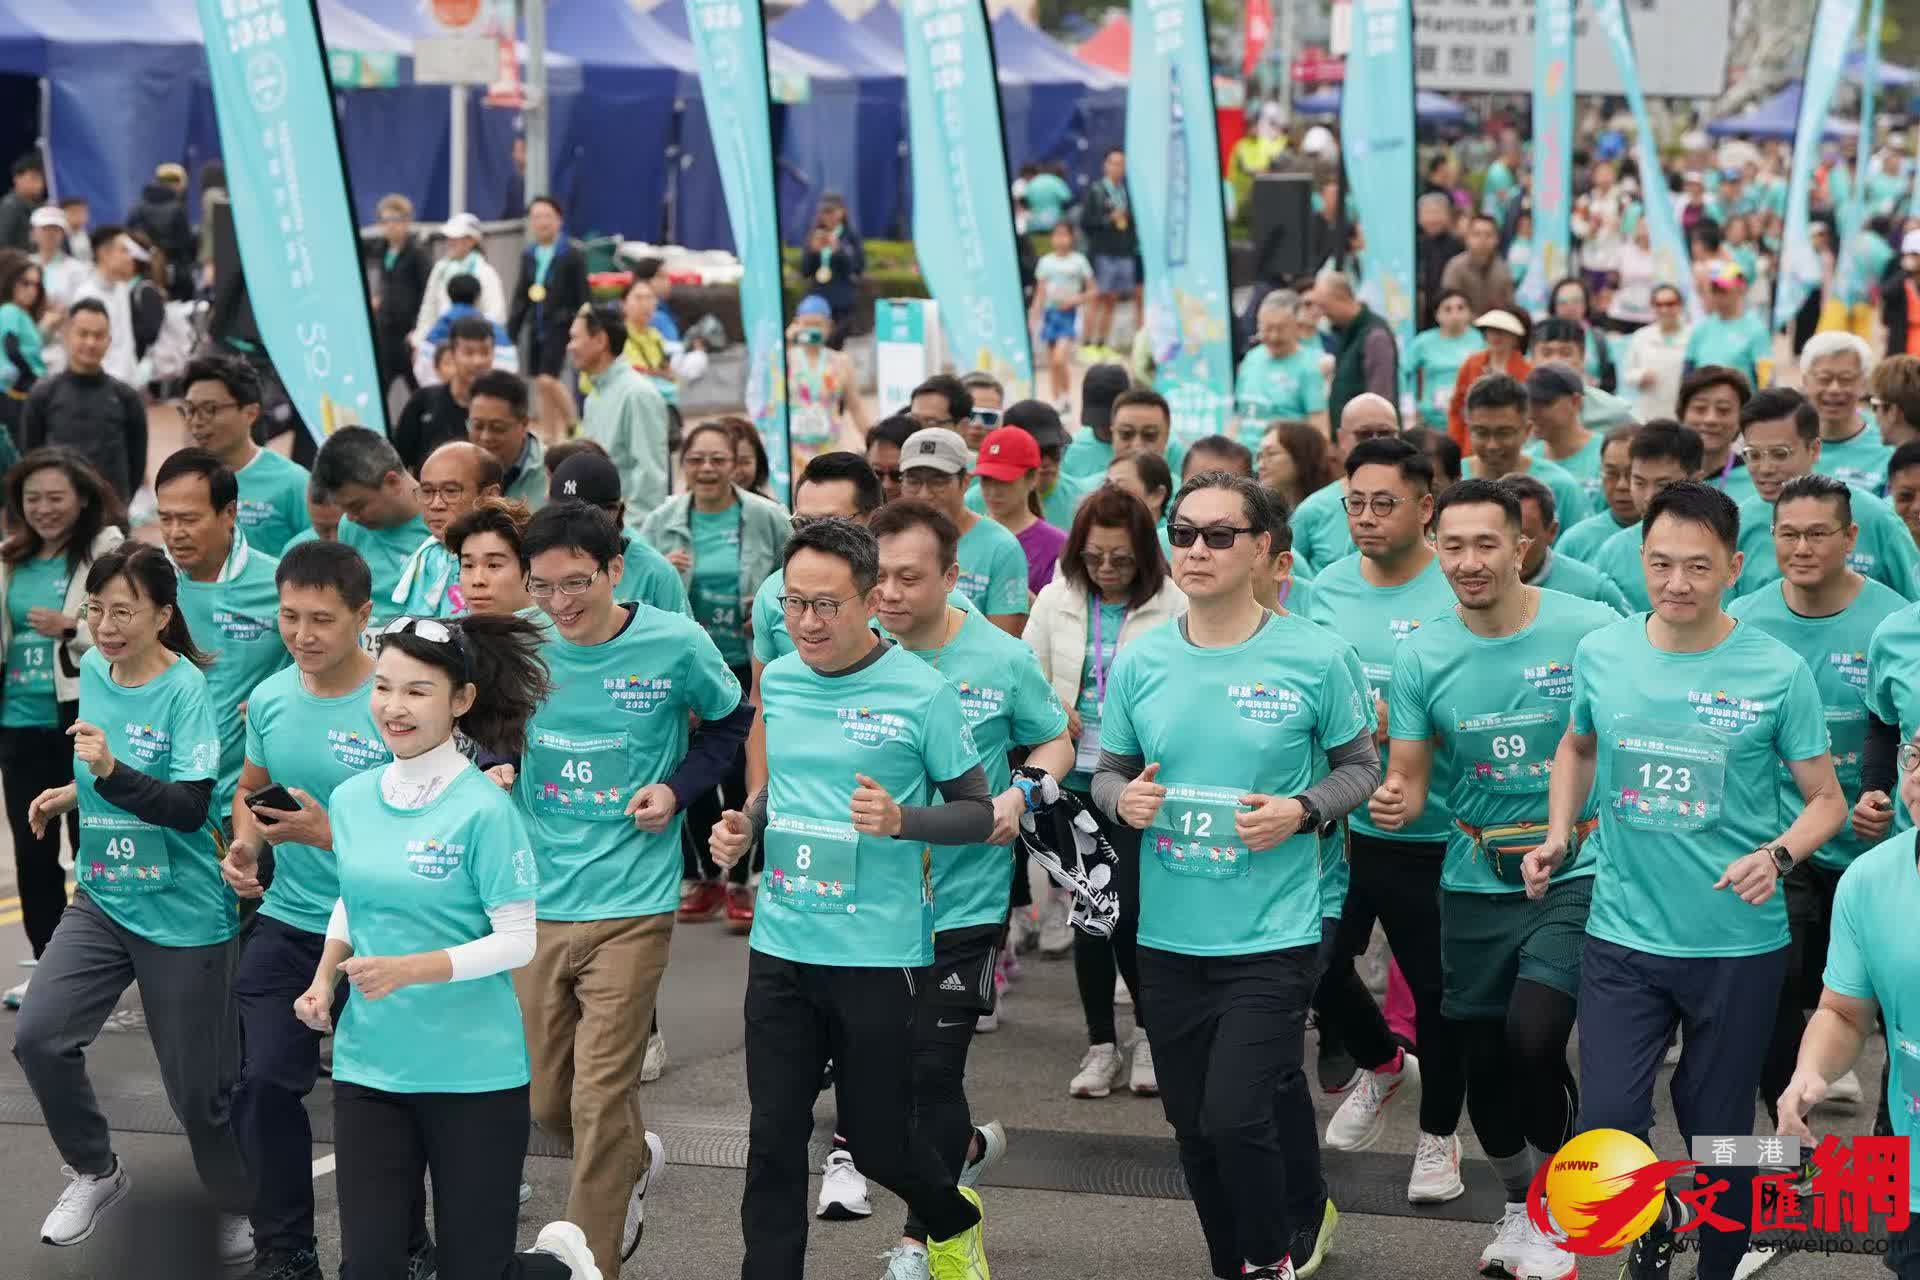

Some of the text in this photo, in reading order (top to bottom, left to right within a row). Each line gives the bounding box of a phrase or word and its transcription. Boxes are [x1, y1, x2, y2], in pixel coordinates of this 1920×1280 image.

[24, 647, 44, 666] 13
[625, 700, 650, 709] 2026
[1250, 709, 1277, 719] 2026
[1710, 716, 1737, 728] 2026
[853, 731, 876, 741] 2026
[135, 747, 154, 759] 2026
[1492, 734, 1526, 759] 69
[343, 753, 366, 766] 2026
[561, 759, 593, 783] 46
[1639, 762, 1691, 792] 123
[1180, 810, 1212, 837] 12
[106, 837, 135, 860] 49
[796, 844, 811, 870] 8
[417, 864, 443, 874] 2026
